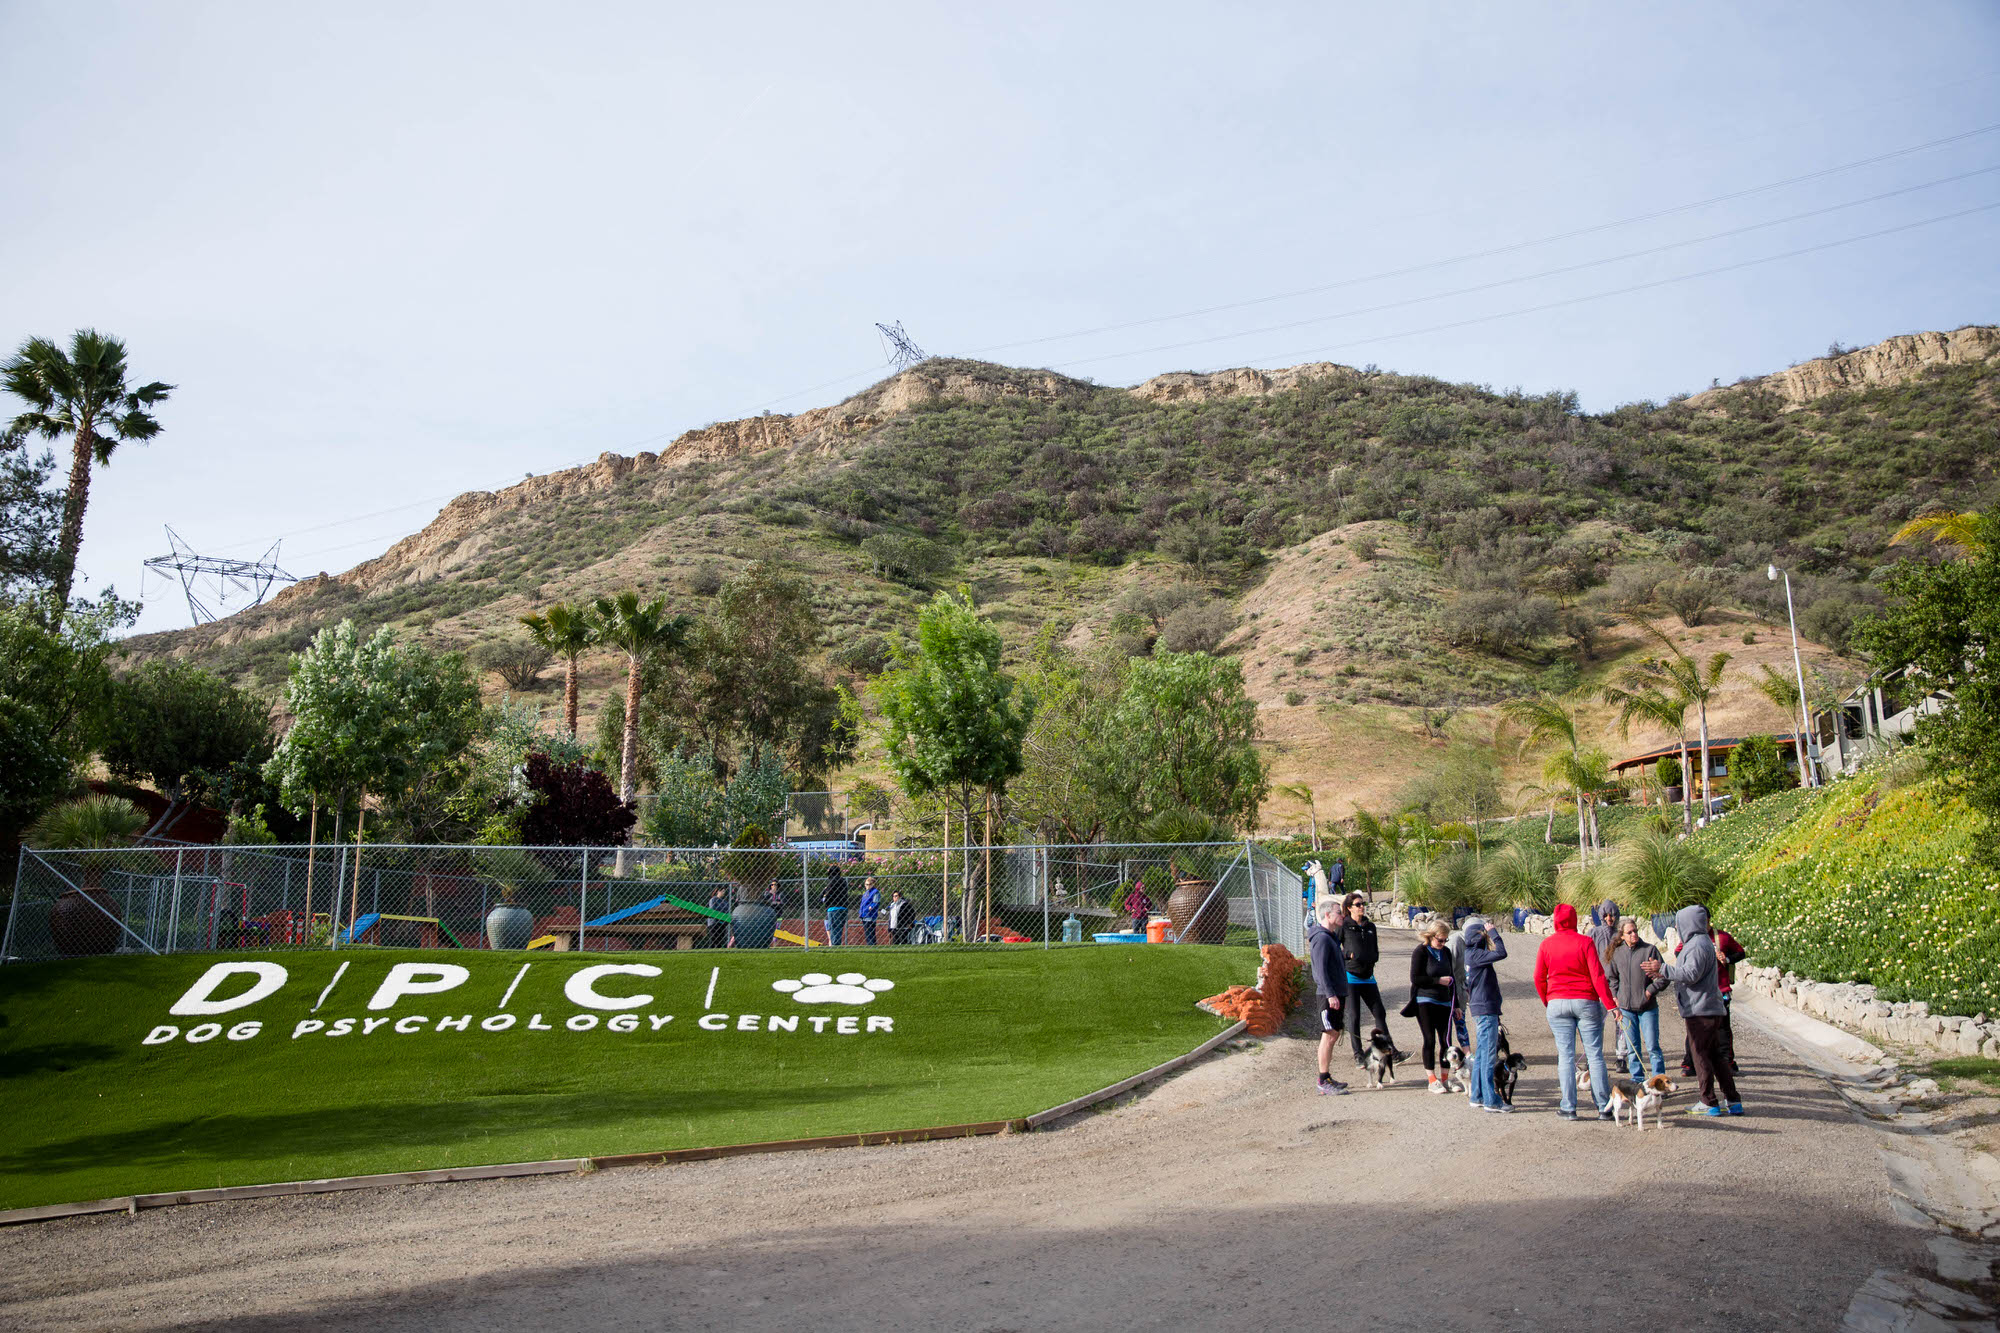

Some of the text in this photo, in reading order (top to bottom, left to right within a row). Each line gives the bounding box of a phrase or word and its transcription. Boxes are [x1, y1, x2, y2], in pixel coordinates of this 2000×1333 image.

[141, 1013, 894, 1045] DOG PSYCHOLOGY CENTER
